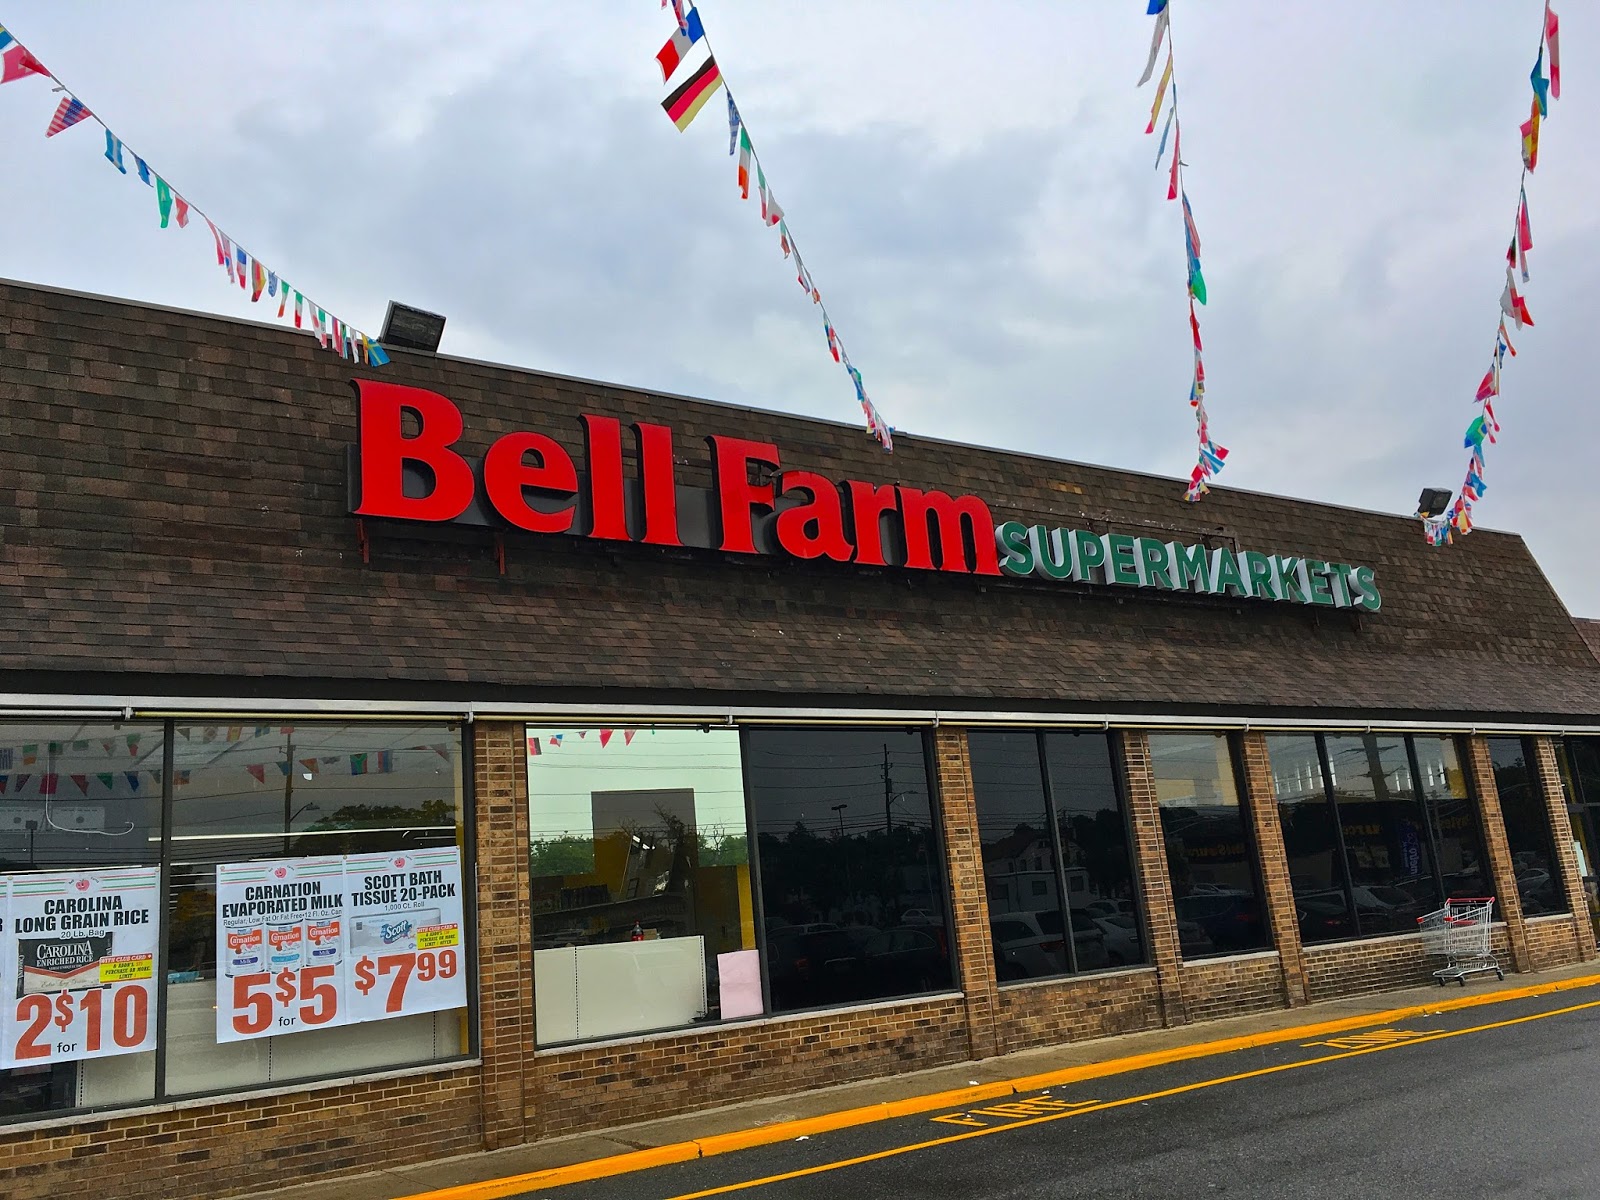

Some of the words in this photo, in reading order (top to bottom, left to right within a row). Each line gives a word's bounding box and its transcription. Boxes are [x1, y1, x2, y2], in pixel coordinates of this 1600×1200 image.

[353, 378, 684, 547] Bell
[708, 434, 1002, 578] Farm
[995, 520, 1382, 612] SUPERMARKETS
[364, 874, 406, 890] SCOTT
[409, 870, 442, 886] BATH
[246, 882, 321, 901] CARNATION
[352, 889, 398, 906] TISSUE
[400, 884, 456, 902] 20-PACK
[44, 896, 122, 914] CAROLINA
[222, 898, 308, 918] EVAPORATED
[310, 894, 343, 910] MILK
[384, 903, 401, 912] 1,000
[15, 917, 56, 934] LONG
[60, 913, 110, 930] GRAIN
[114, 910, 149, 926] RICE
[386, 920, 407, 938] Scott
[61, 930, 72, 939] 20
[88, 928, 105, 938] Bag
[230, 936, 260, 946] Carnation
[271, 932, 300, 943] Carnation
[310, 927, 338, 938] Carnation
[36, 940, 93, 960] CAROLINA
[36, 956, 75, 968] ENRICHED
[76, 955, 94, 964] RICE
[232, 972, 273, 1034] 5
[275, 964, 337, 1024] $5
[15, 994, 52, 1060] 2
[55, 985, 148, 1051] $10
[278, 1016, 296, 1026] for
[57, 1042, 77, 1053] for
[929, 1096, 1102, 1126] FIRE
